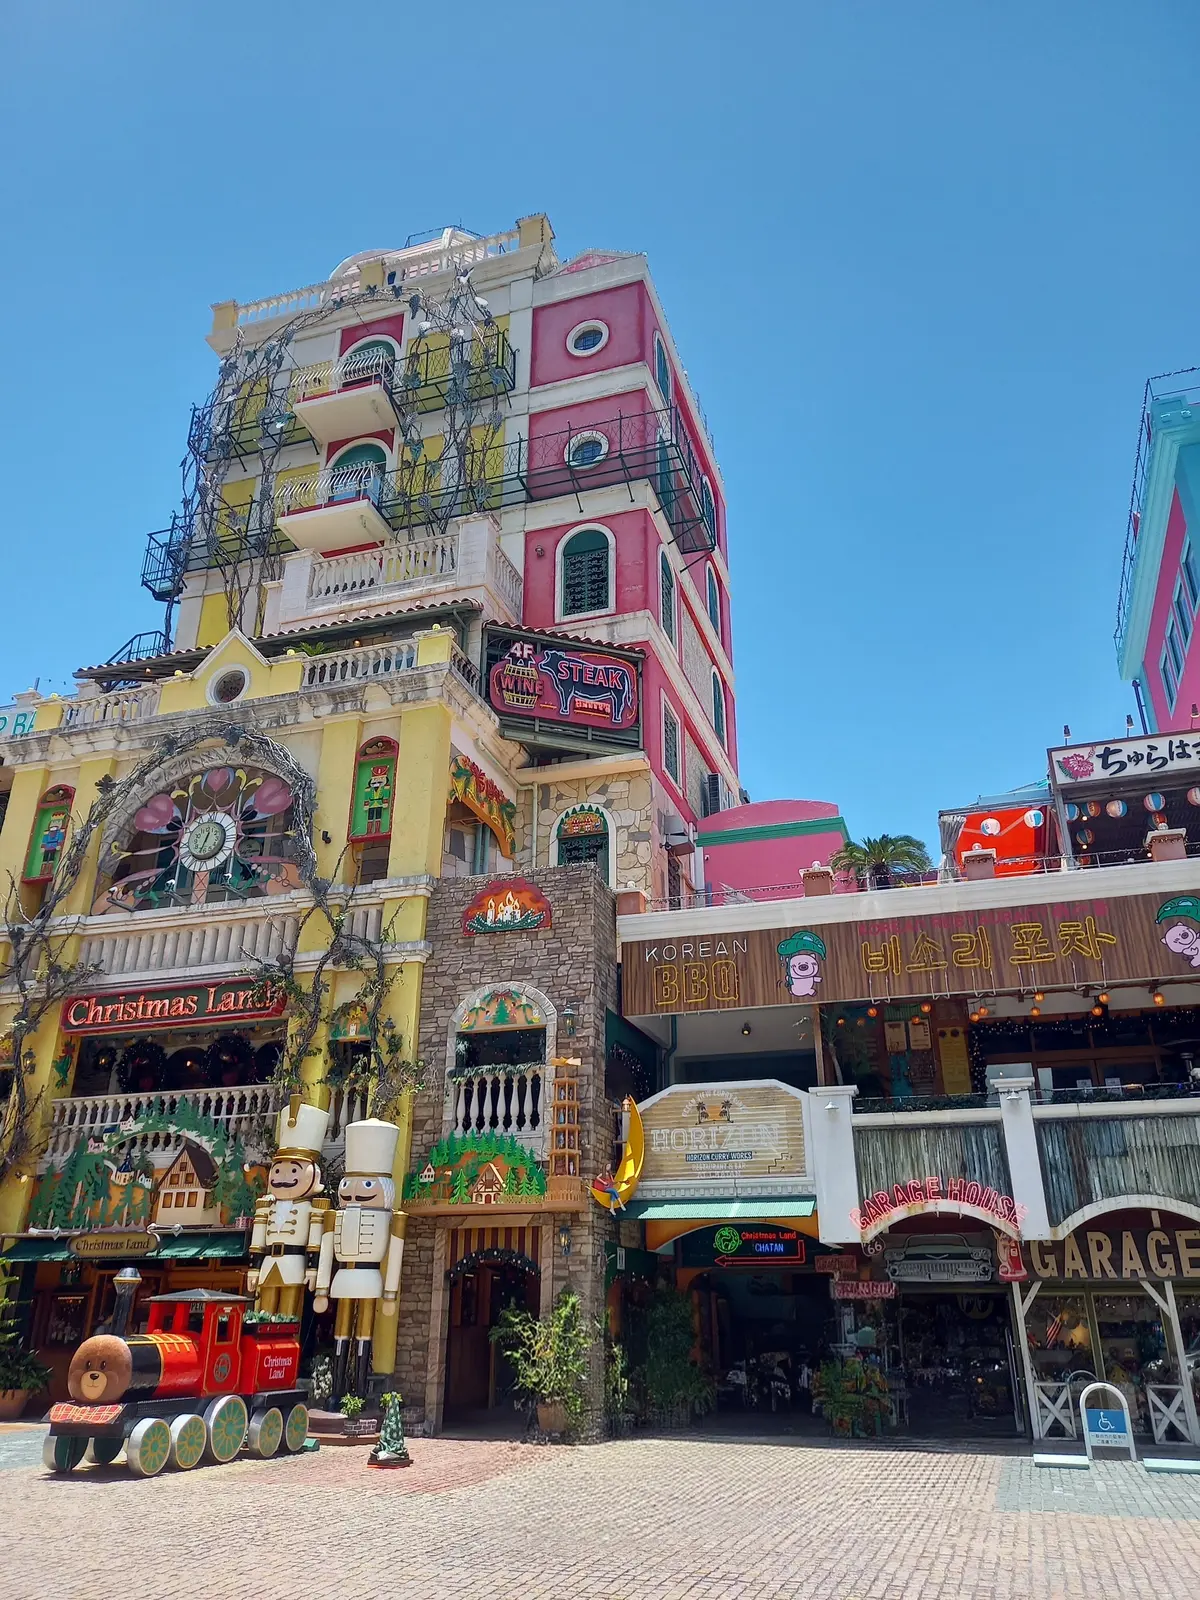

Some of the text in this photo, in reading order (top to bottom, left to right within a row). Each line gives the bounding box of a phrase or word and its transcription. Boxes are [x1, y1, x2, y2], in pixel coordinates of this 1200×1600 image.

[510, 641, 534, 659] 4F
[500, 673, 544, 695] WINE
[557, 660, 623, 690] STEAK
[645, 939, 748, 962] KOREAN
[861, 915, 1116, 975] 비소리 포차
[654, 959, 739, 1005] BBQ
[67, 994, 199, 1026] Christmas
[650, 1123, 780, 1151] HORIZON
[711, 1152, 729, 1160] CURRY
[731, 1151, 752, 1159] WORKS
[849, 1176, 1030, 1231] GARAGE HOUSE
[75, 1238, 150, 1251] Christmas Land
[741, 1231, 797, 1240] Christmas Land
[754, 1243, 784, 1253] CHATAN
[867, 1241, 883, 1255] 66
[1030, 1230, 1200, 1278] GARAGE
[263, 1355, 293, 1368] Christmas
[268, 1368, 286, 1380] Land
